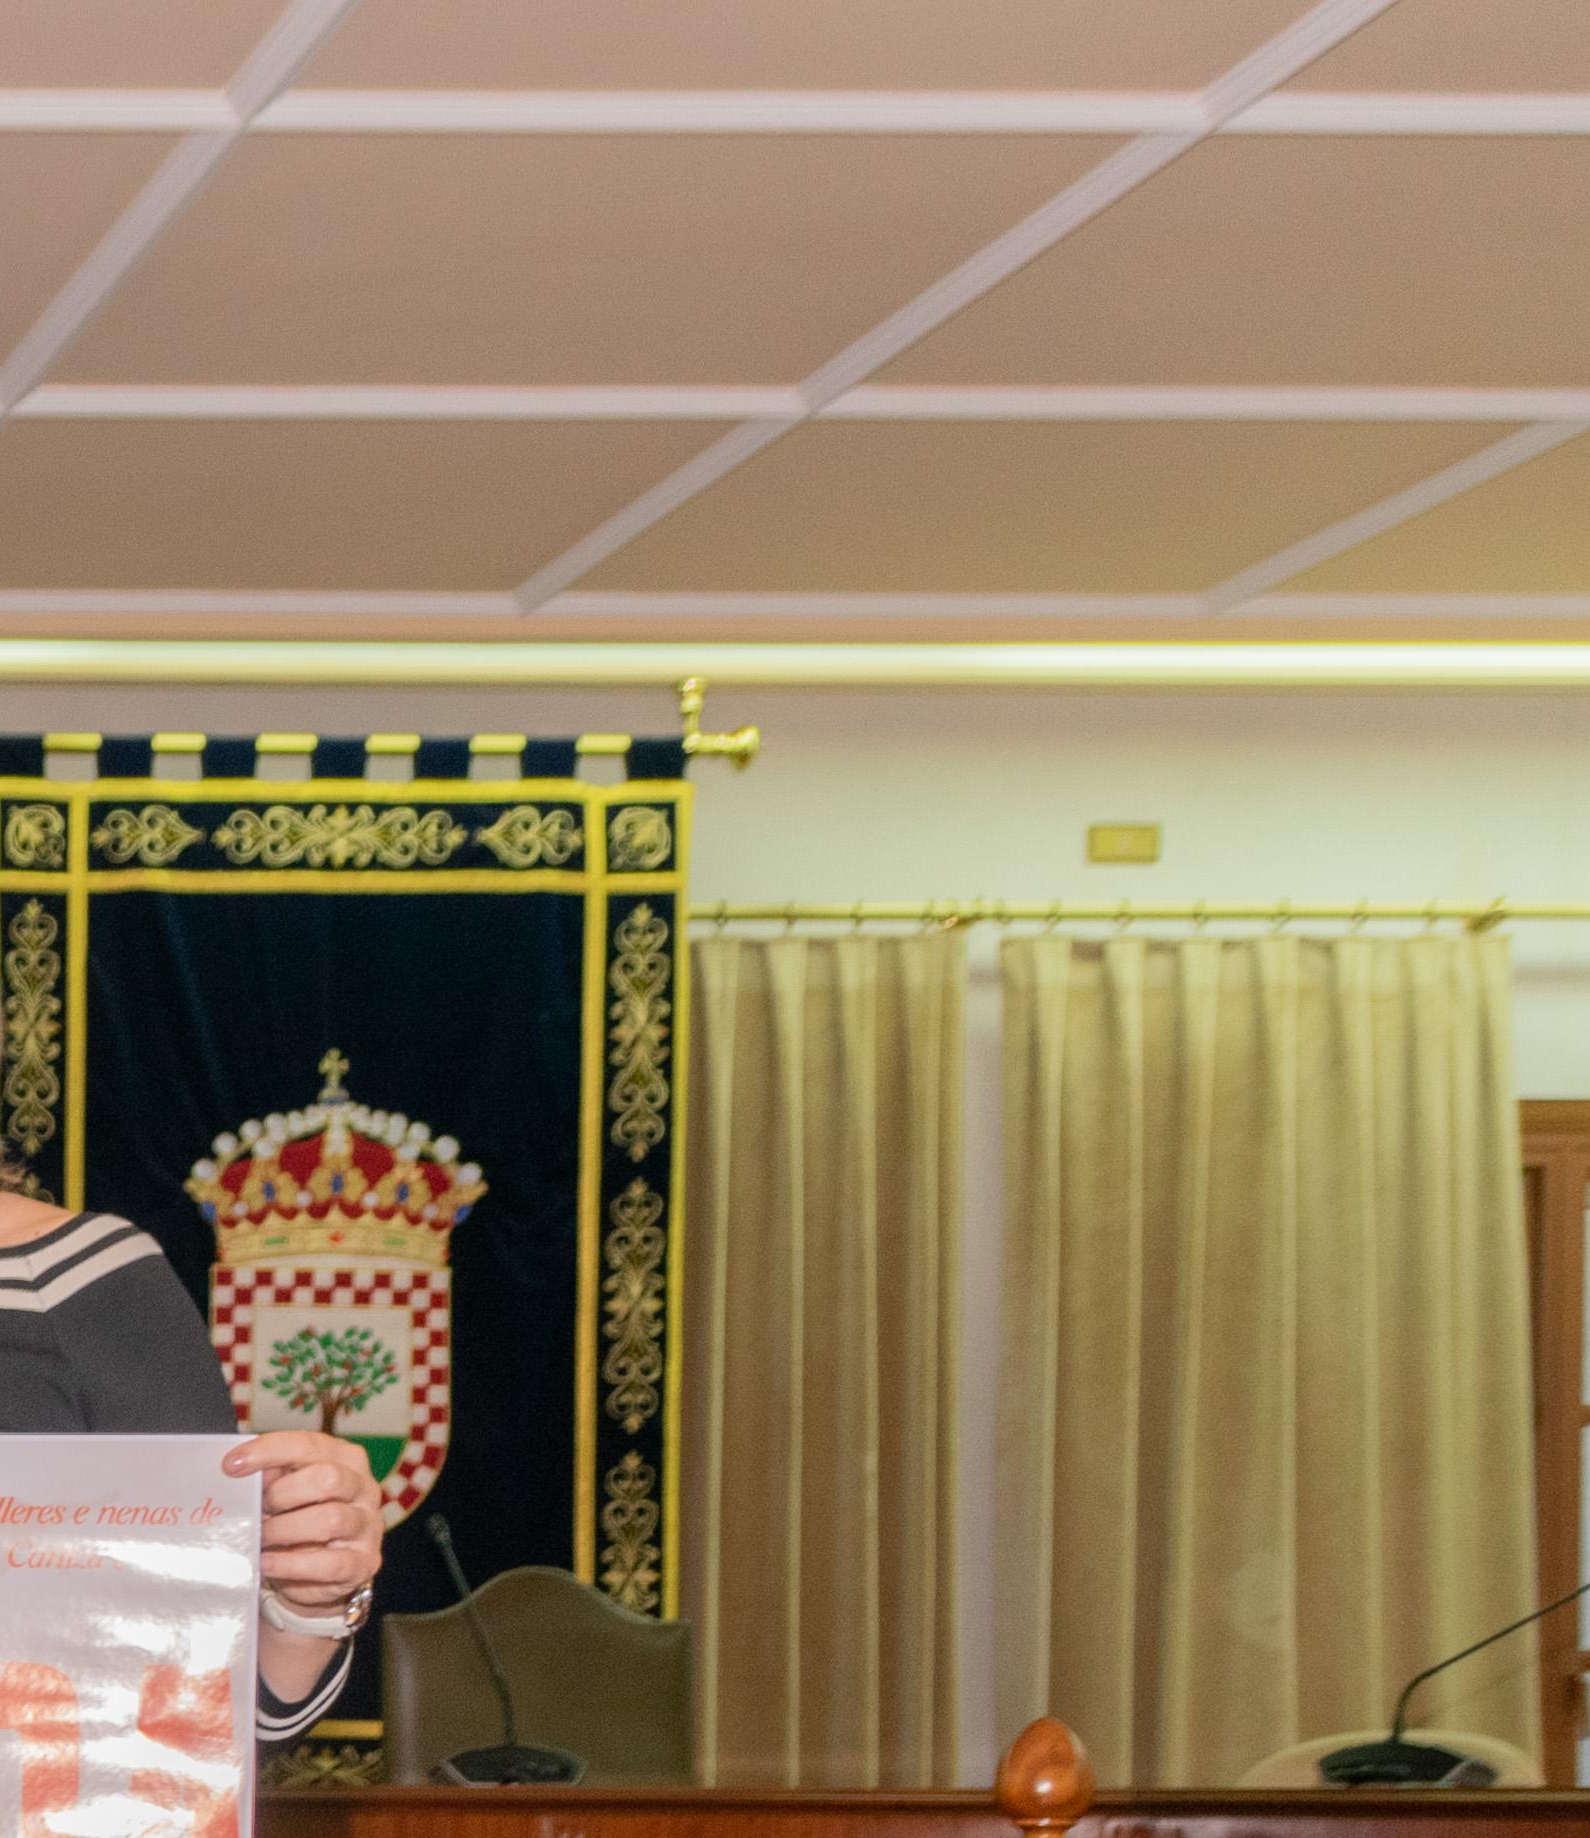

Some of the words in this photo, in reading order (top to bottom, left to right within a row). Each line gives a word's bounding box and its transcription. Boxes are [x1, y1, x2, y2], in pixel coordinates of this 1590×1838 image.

[73, 1503, 90, 1525] e
[96, 1503, 183, 1527] nenas
[189, 1497, 224, 1527] de
